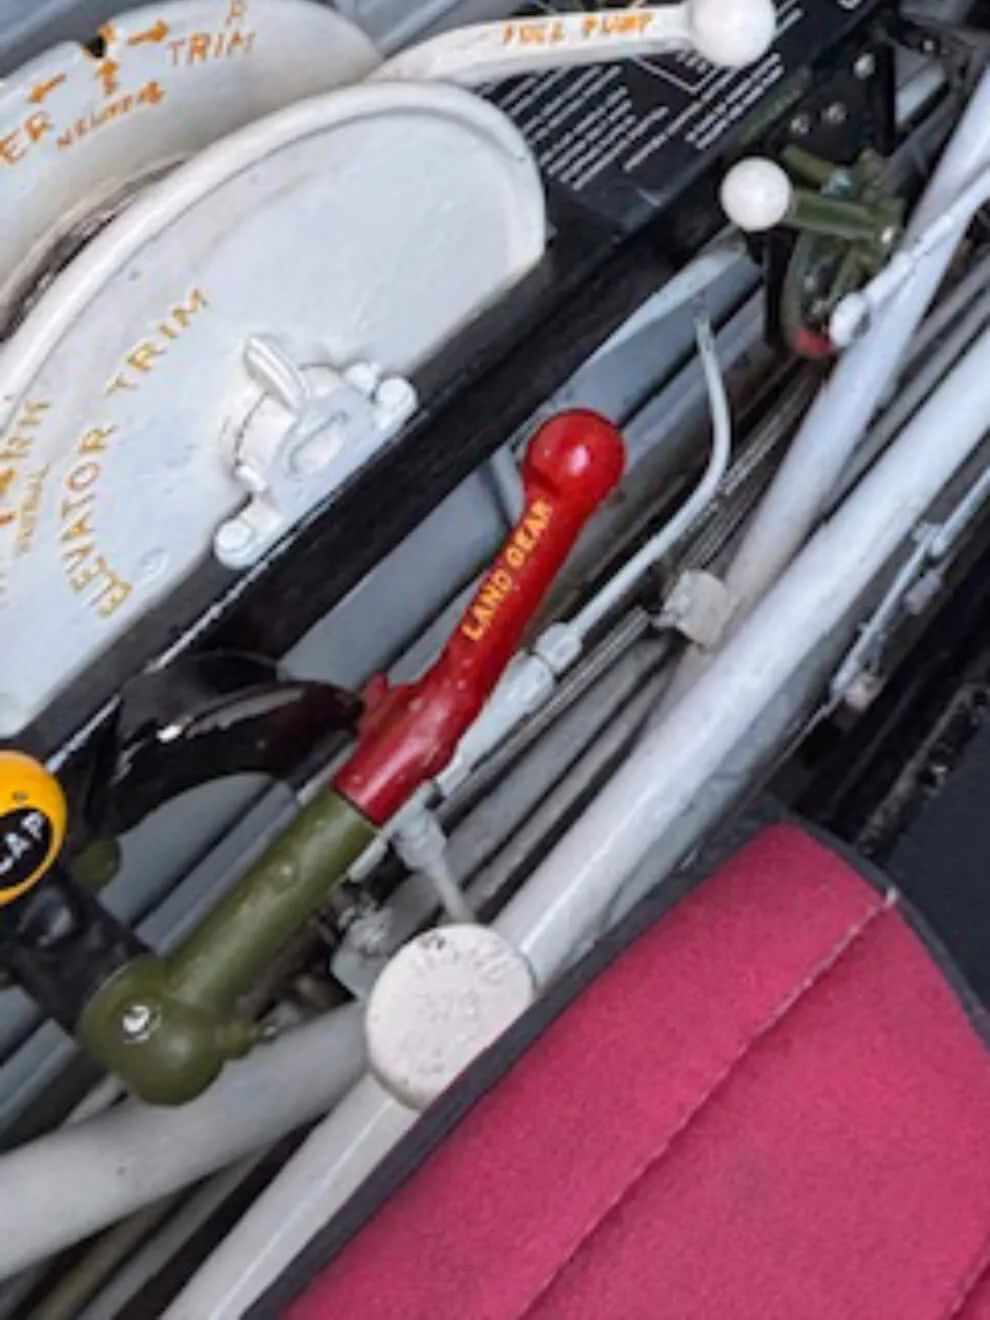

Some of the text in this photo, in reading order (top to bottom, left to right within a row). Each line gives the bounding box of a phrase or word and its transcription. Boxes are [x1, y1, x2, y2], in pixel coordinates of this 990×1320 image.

[167, 27, 257, 67] TRIM
[59, 287, 209, 619] ELEVATOR TRIM
[461, 499, 553, 641] LAND GEAR
